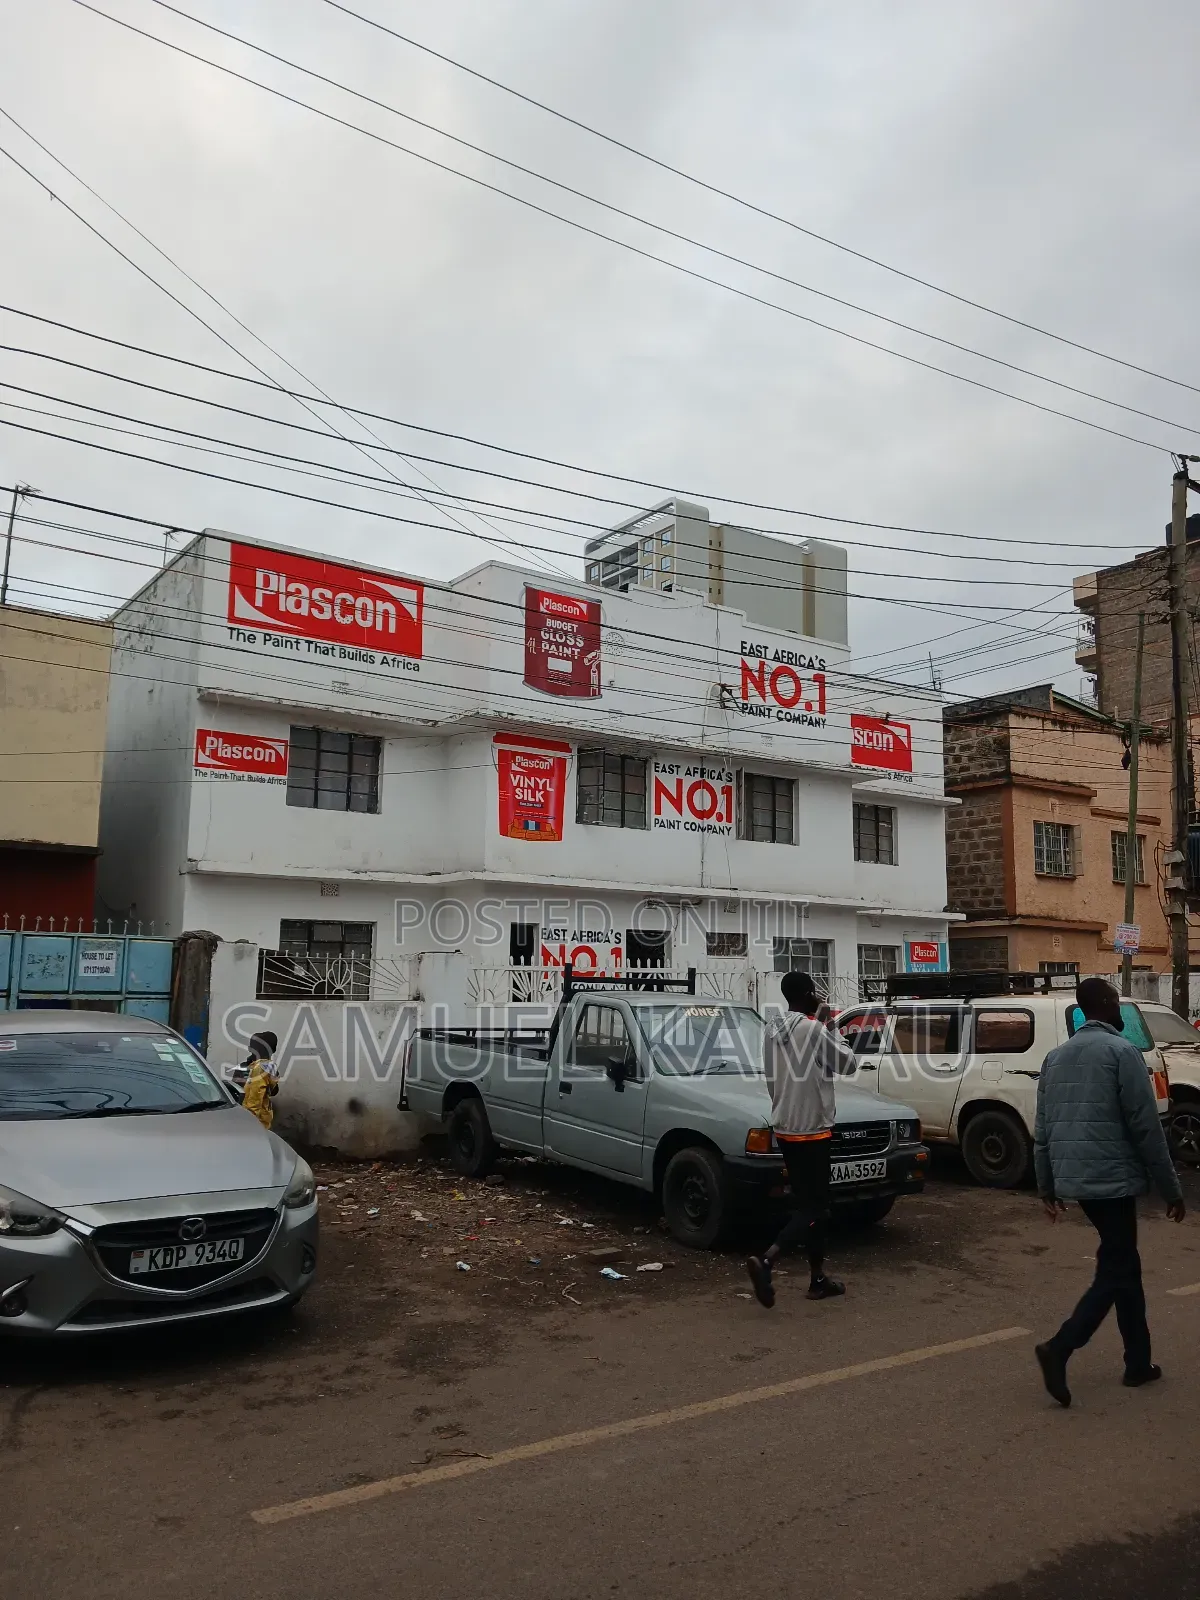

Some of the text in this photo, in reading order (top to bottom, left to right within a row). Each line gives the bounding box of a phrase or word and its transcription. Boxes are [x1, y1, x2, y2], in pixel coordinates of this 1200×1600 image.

[255, 568, 396, 633] Plascon
[543, 597, 580, 616] Plascon
[546, 618, 578, 633] BUDGET
[541, 628, 585, 647] GLOSS
[228, 627, 420, 672] The Paint That Builds Africa
[541, 641, 581, 660] PAINT
[740, 640, 826, 671] EAST AFRICA'S
[741, 656, 826, 715] NO.1
[741, 703, 827, 729] PAINT COMPANY
[853, 727, 894, 752] scon
[205, 736, 276, 763] Plascon
[516, 756, 550, 770] Plascon
[654, 762, 733, 782] EAST AFRICA'S
[194, 769, 287, 786] The Paint That Builds Africa
[510, 773, 554, 792] VINYL
[515, 788, 544, 803] SILK
[654, 775, 733, 824] NO.1
[654, 818, 732, 836] PAINT COMPANY
[541, 927, 622, 944] EAST AFRICA'S
[98, 952, 105, 961] TO
[105, 952, 114, 961] LET
[541, 942, 622, 979] NO.1
[914, 945, 937, 957] Plascon
[842, 1131, 867, 1139] ISUZU
[831, 1161, 885, 1181] KAA 359Z
[148, 1239, 240, 1270] KDP 934Q
